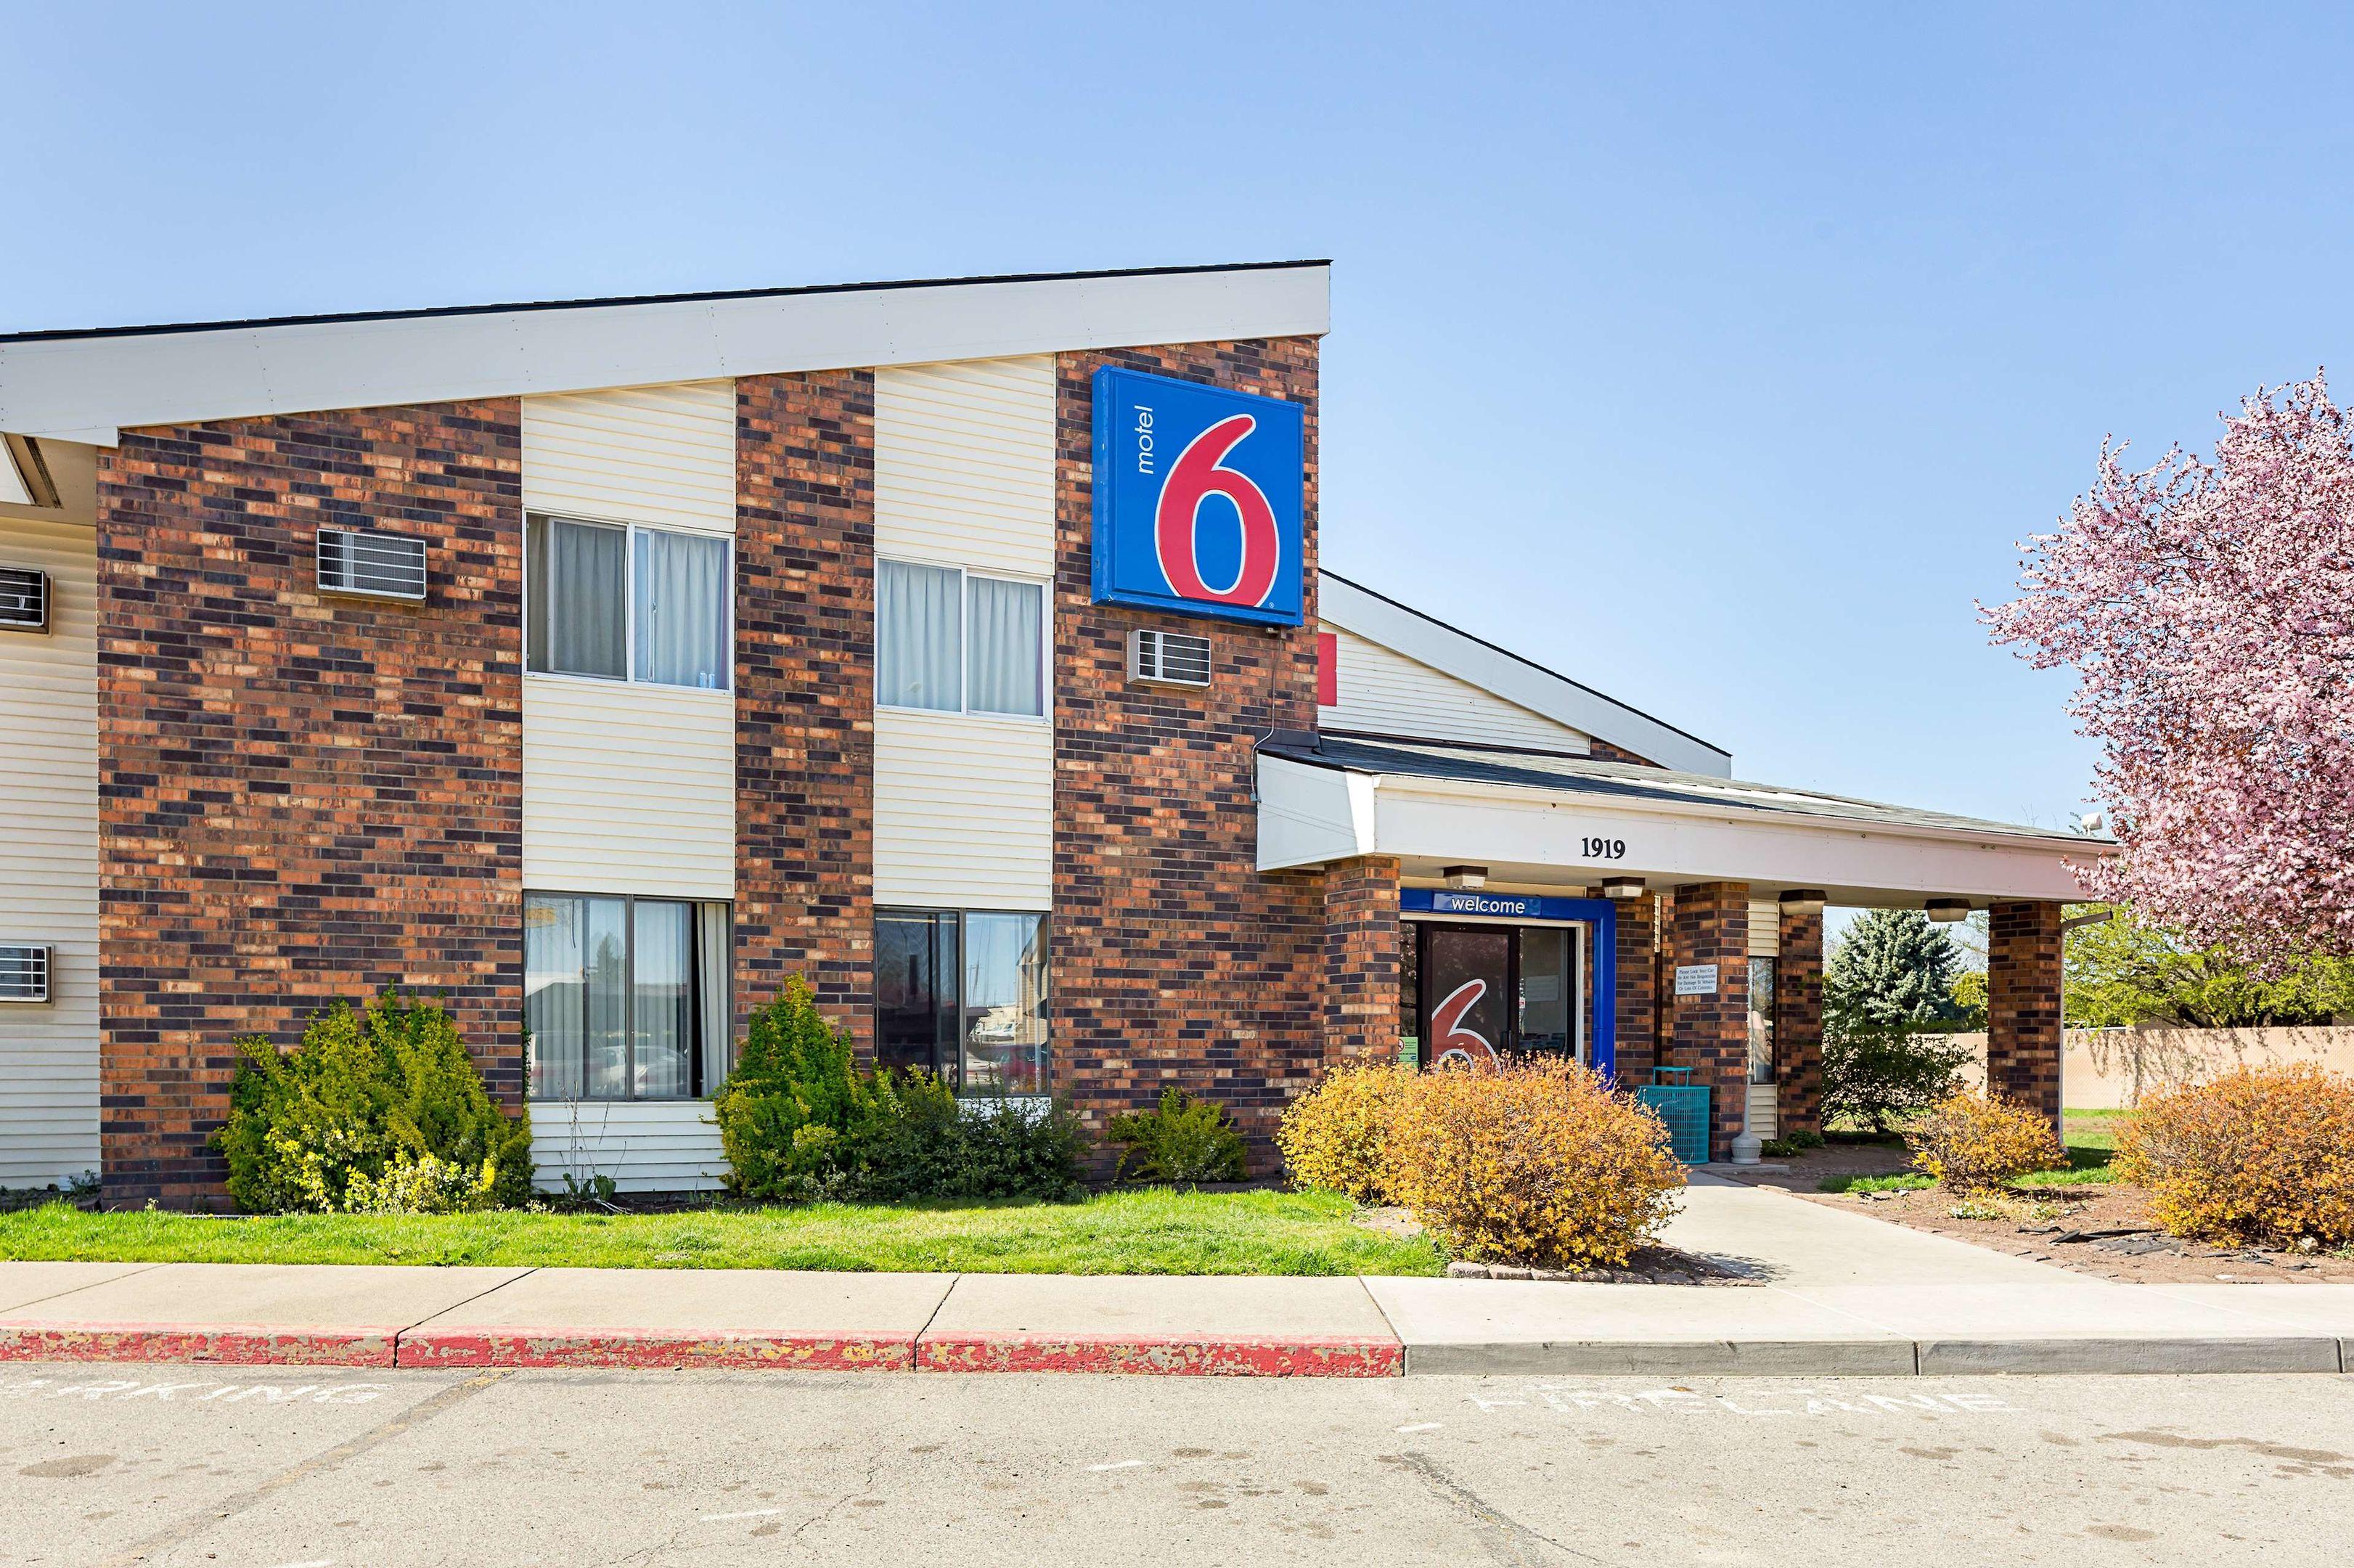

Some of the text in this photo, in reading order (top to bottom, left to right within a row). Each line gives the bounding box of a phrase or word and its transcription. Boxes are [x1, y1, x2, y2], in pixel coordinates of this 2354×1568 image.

[1134, 405, 1154, 474] motel
[1154, 413, 1280, 608] 6
[1582, 837, 1626, 859] 1919
[1452, 896, 1525, 914] welcome
